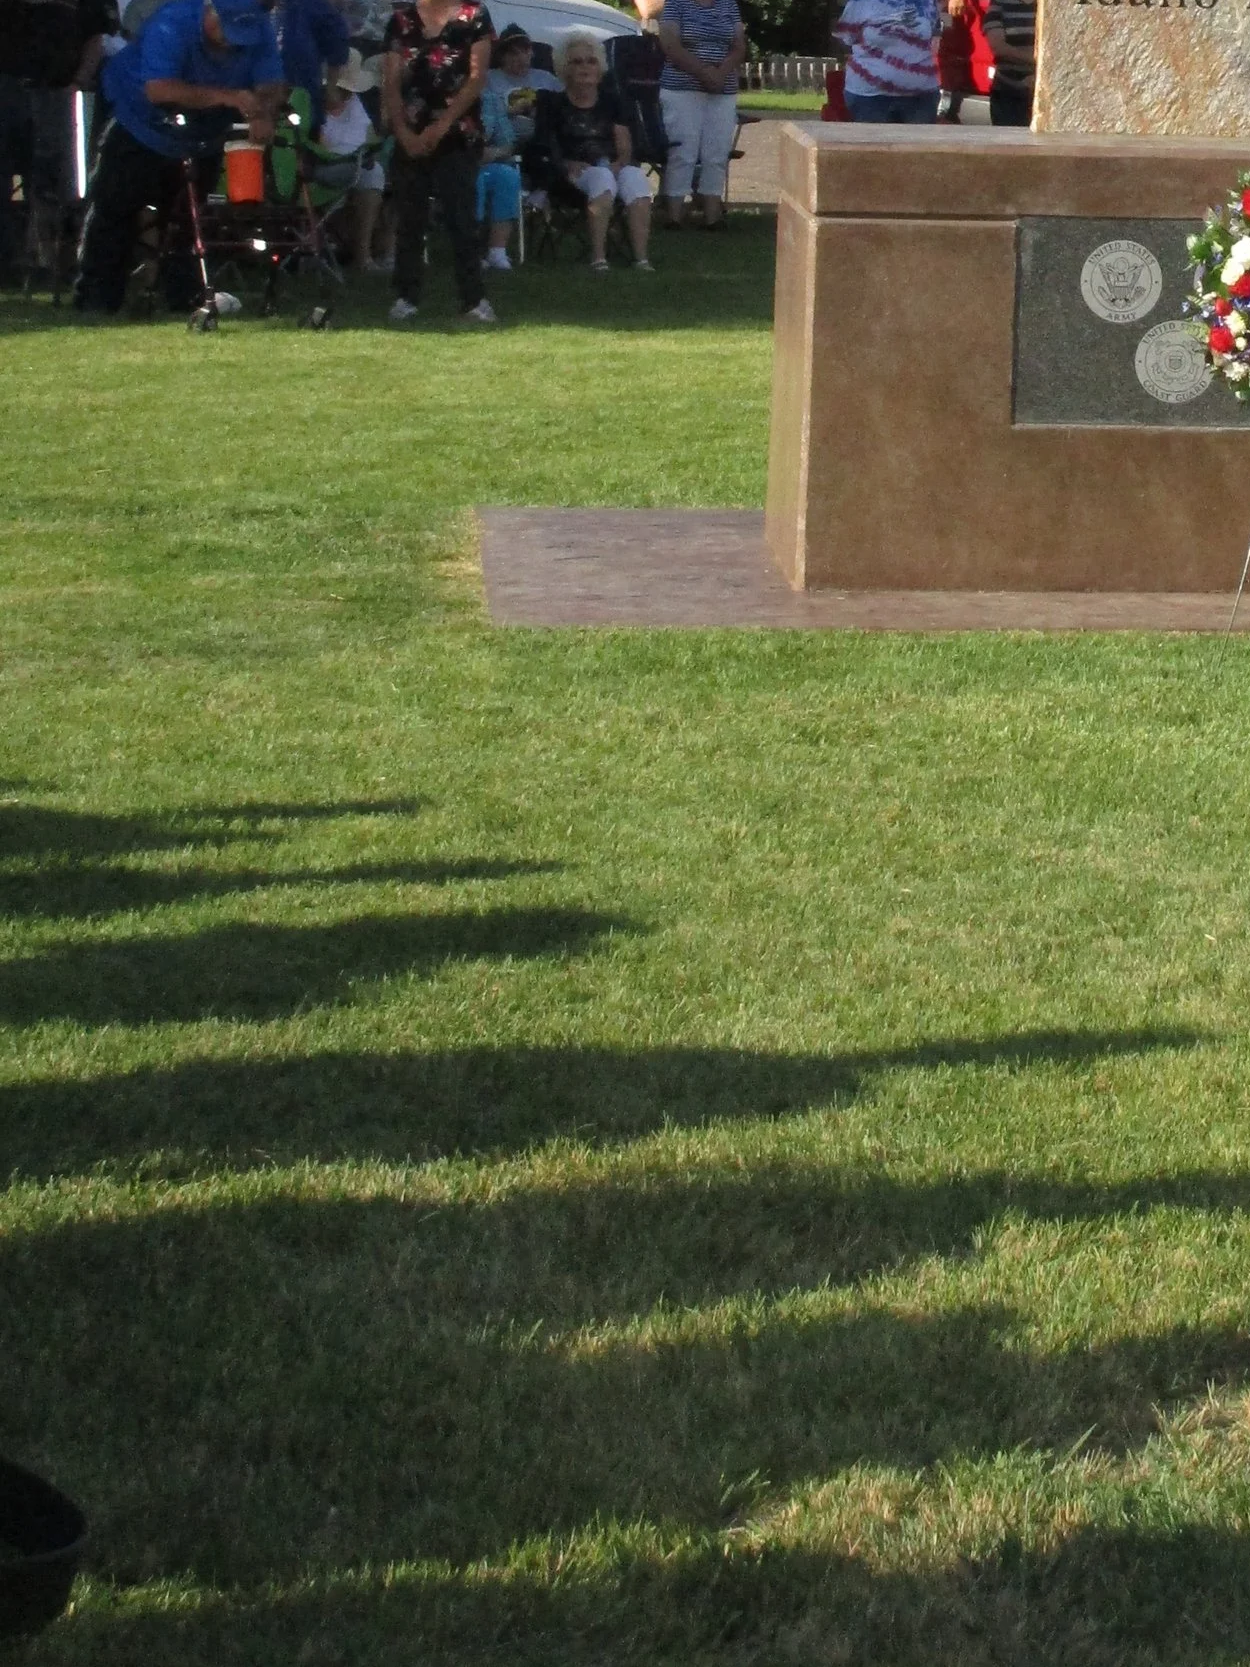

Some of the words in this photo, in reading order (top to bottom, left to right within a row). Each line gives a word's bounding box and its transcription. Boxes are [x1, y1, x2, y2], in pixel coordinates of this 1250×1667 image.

[1088, 242, 1121, 264] UNITED
[1127, 242, 1156, 265] STATES
[1106, 312, 1136, 321] ARMY
[1142, 322, 1176, 344] UNITED
[1143, 379, 1171, 401] COAST
[1176, 380, 1207, 402] GUARD
